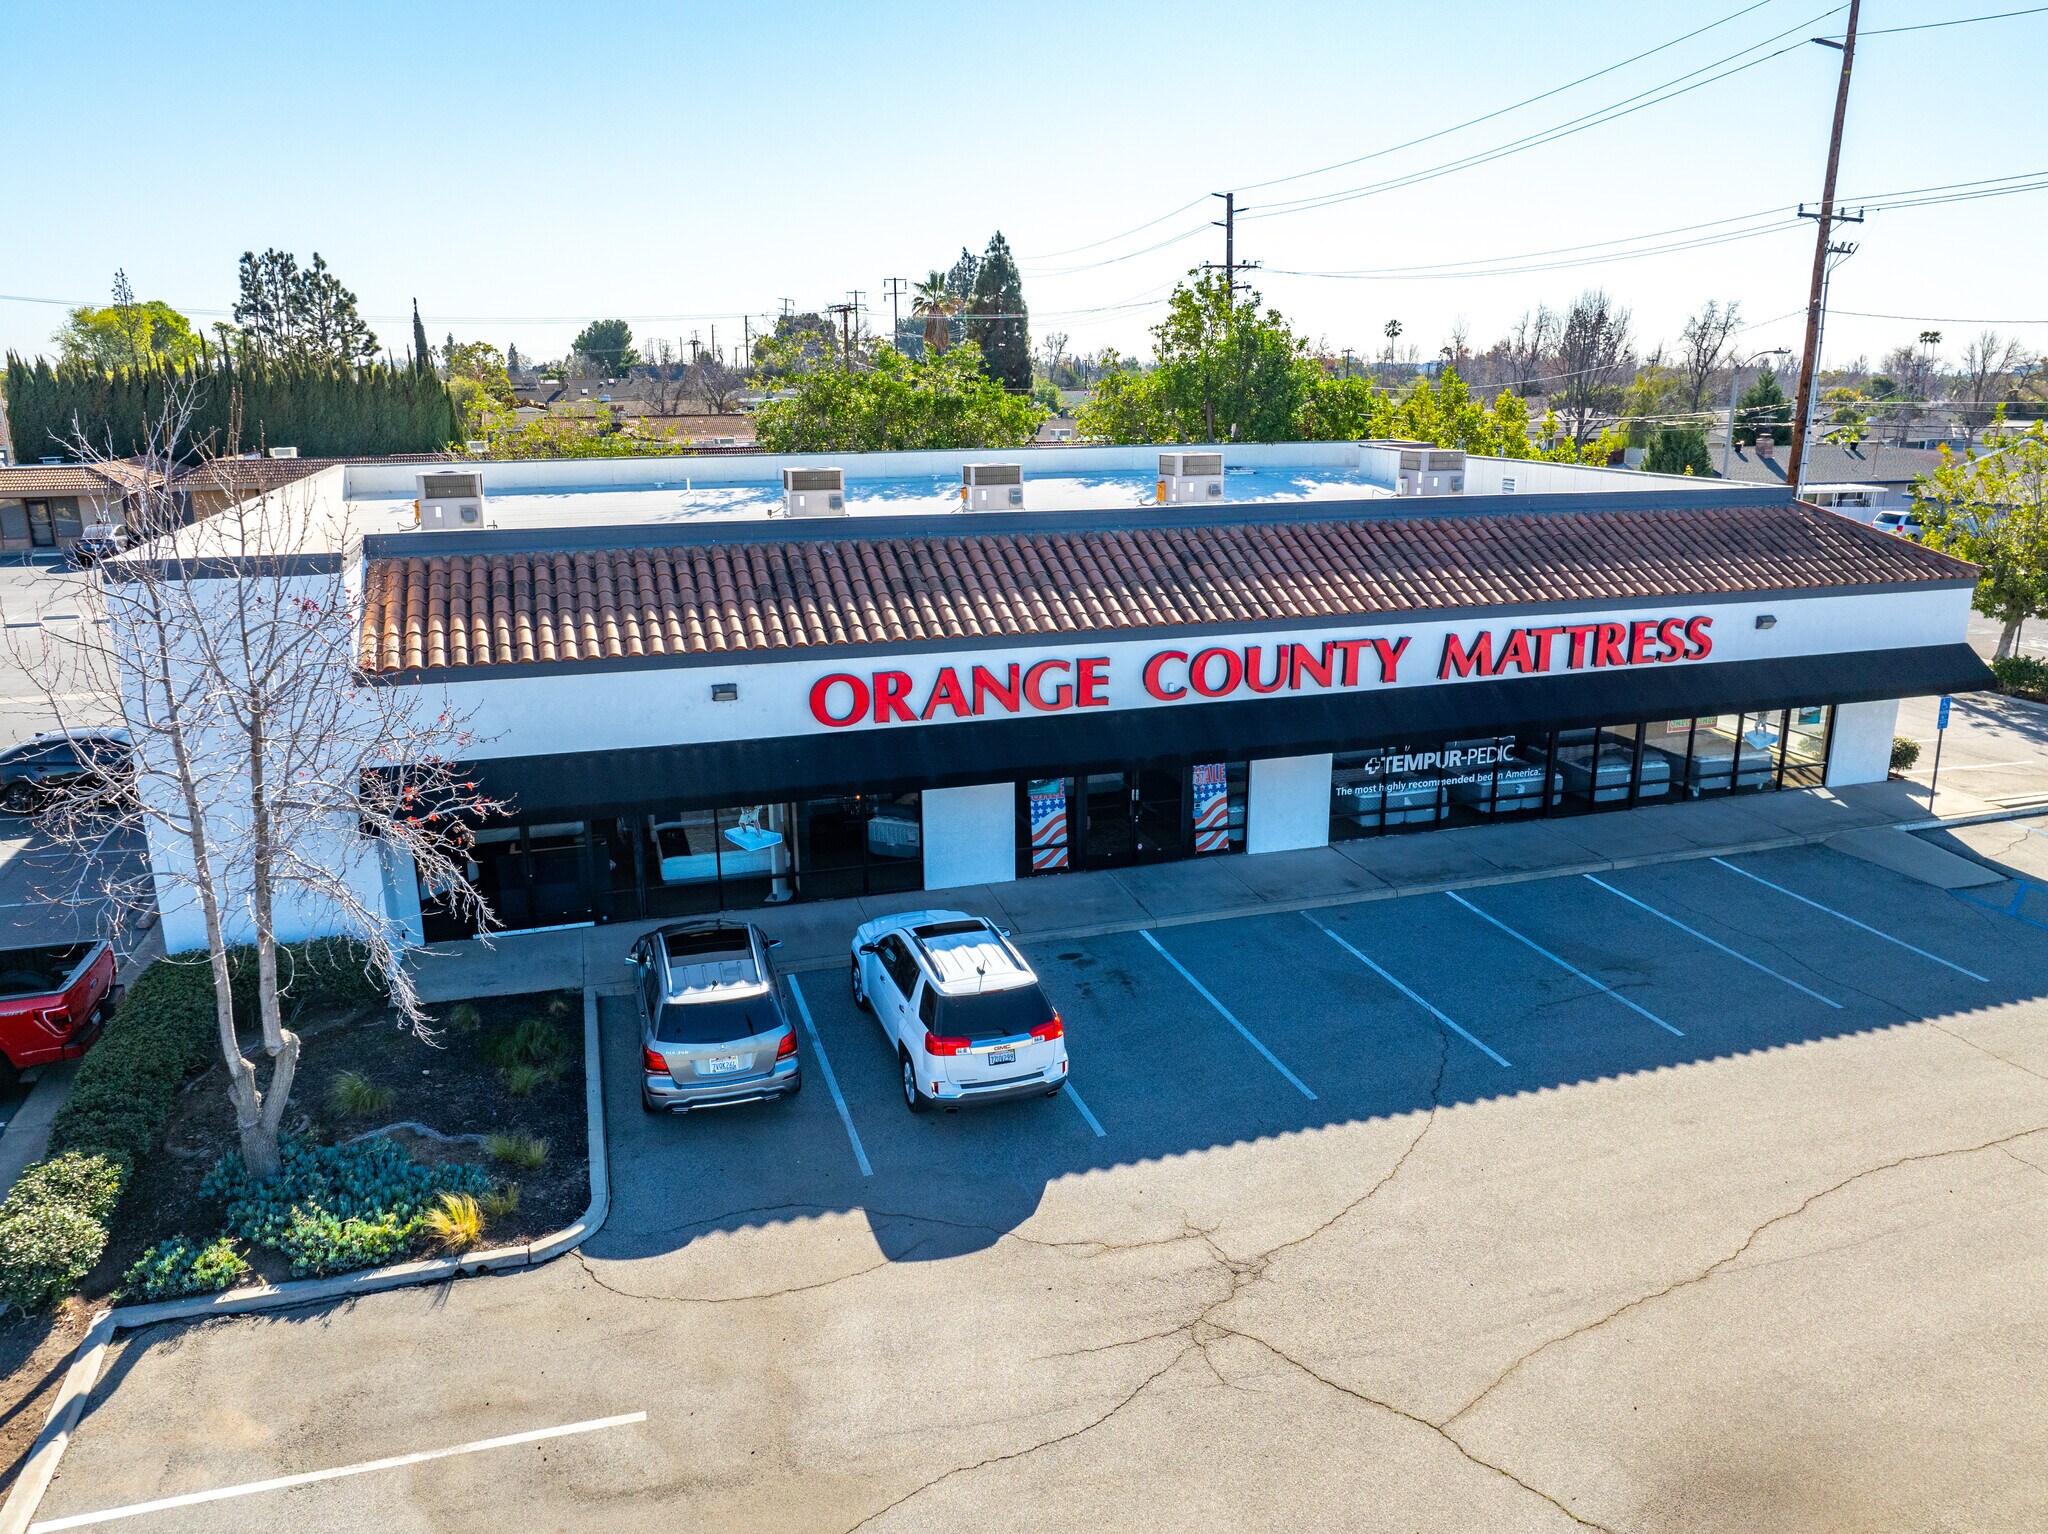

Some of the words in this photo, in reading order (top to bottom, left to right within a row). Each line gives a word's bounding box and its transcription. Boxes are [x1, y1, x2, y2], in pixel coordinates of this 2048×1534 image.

[809, 656, 1110, 727] ORANGE
[1142, 636, 1412, 701] COUNTY
[1436, 615, 1714, 680] MATTRESS
[1381, 744, 1515, 774] TEMPUR-PEDIC
[1193, 764, 1226, 785] SALE
[1336, 787, 1353, 797] The
[1354, 785, 1377, 794] most
[1378, 781, 1406, 793] hghly
[1477, 772, 1493, 782] bed
[994, 1043, 1011, 1051] GMC
